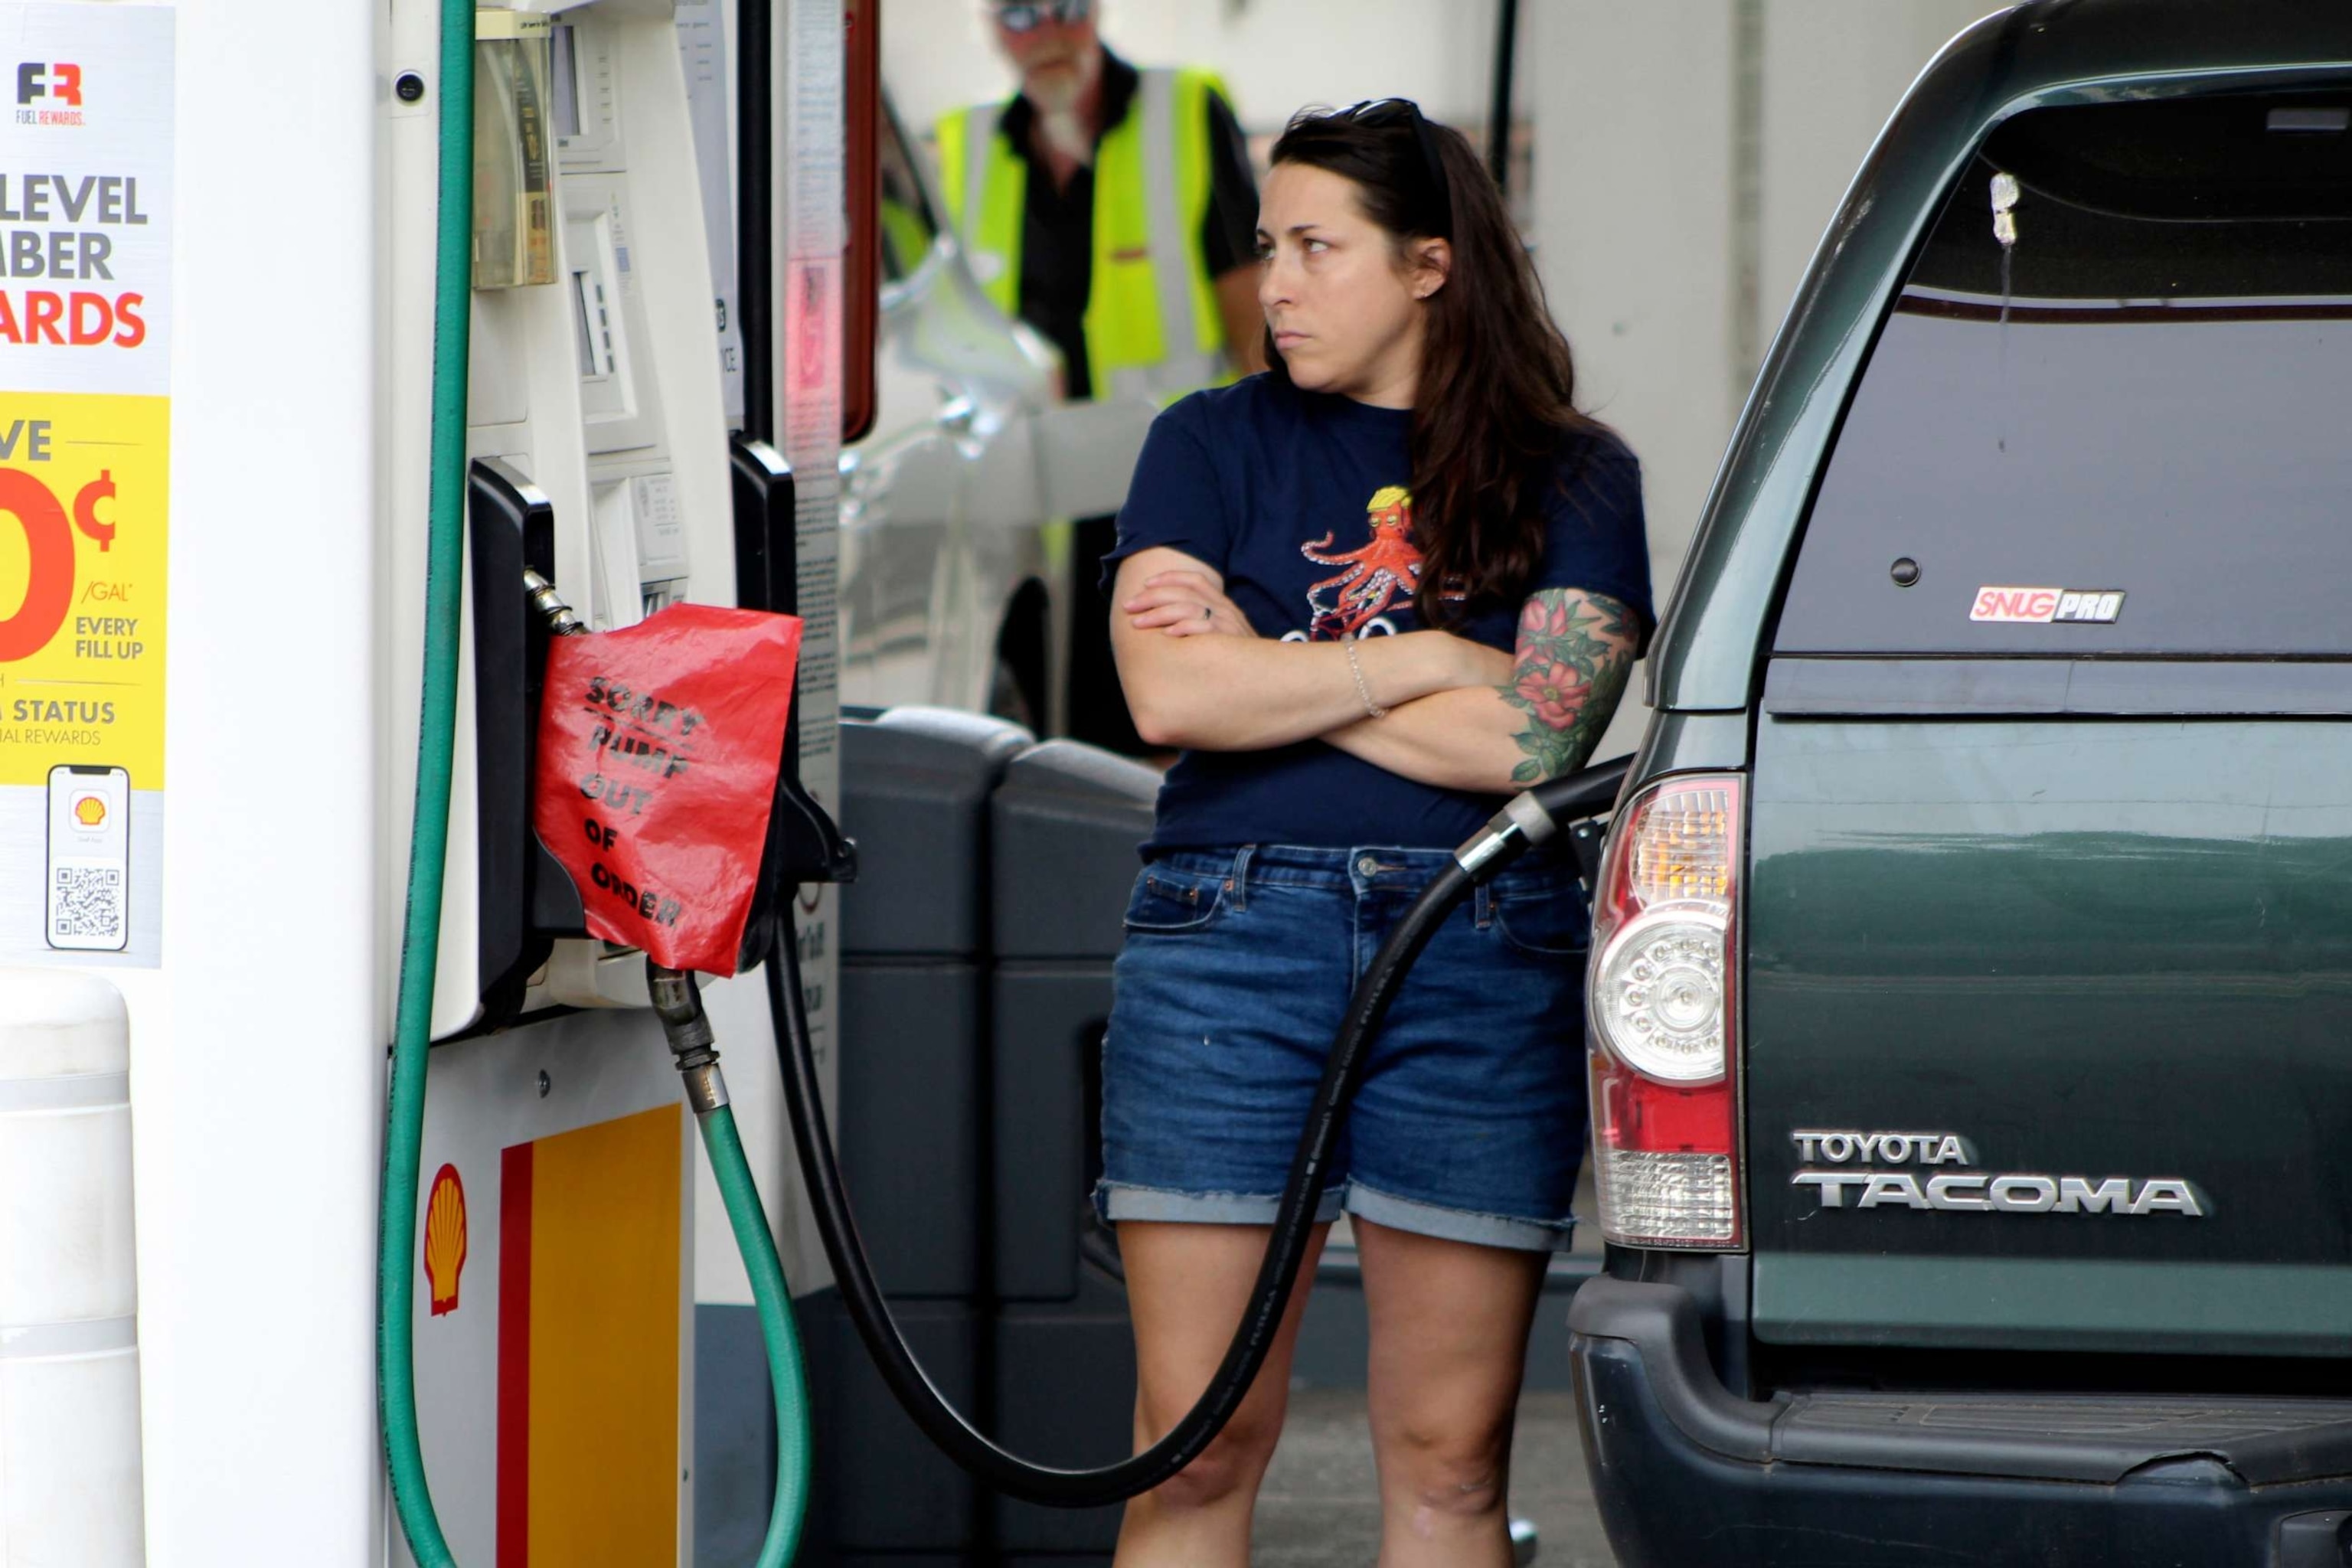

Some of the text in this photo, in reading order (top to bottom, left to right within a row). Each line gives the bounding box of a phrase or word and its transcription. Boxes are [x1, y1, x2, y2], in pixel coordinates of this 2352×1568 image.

[16, 110, 37, 125] FUEL
[0, 230, 115, 280] BER
[76, 616, 138, 636] EVERY
[76, 640, 143, 660] FILL UP
[13, 698, 116, 724] STATUS
[585, 676, 707, 737] SORRY
[25, 728, 102, 746] REWARDS
[587, 724, 689, 780] PUMP
[580, 773, 653, 815] OUT
[585, 818, 618, 852] OF
[591, 861, 682, 928] ORDER
[1793, 1132, 1968, 1166] TOYOTA
[1792, 1171, 2203, 1217] TACOMA
